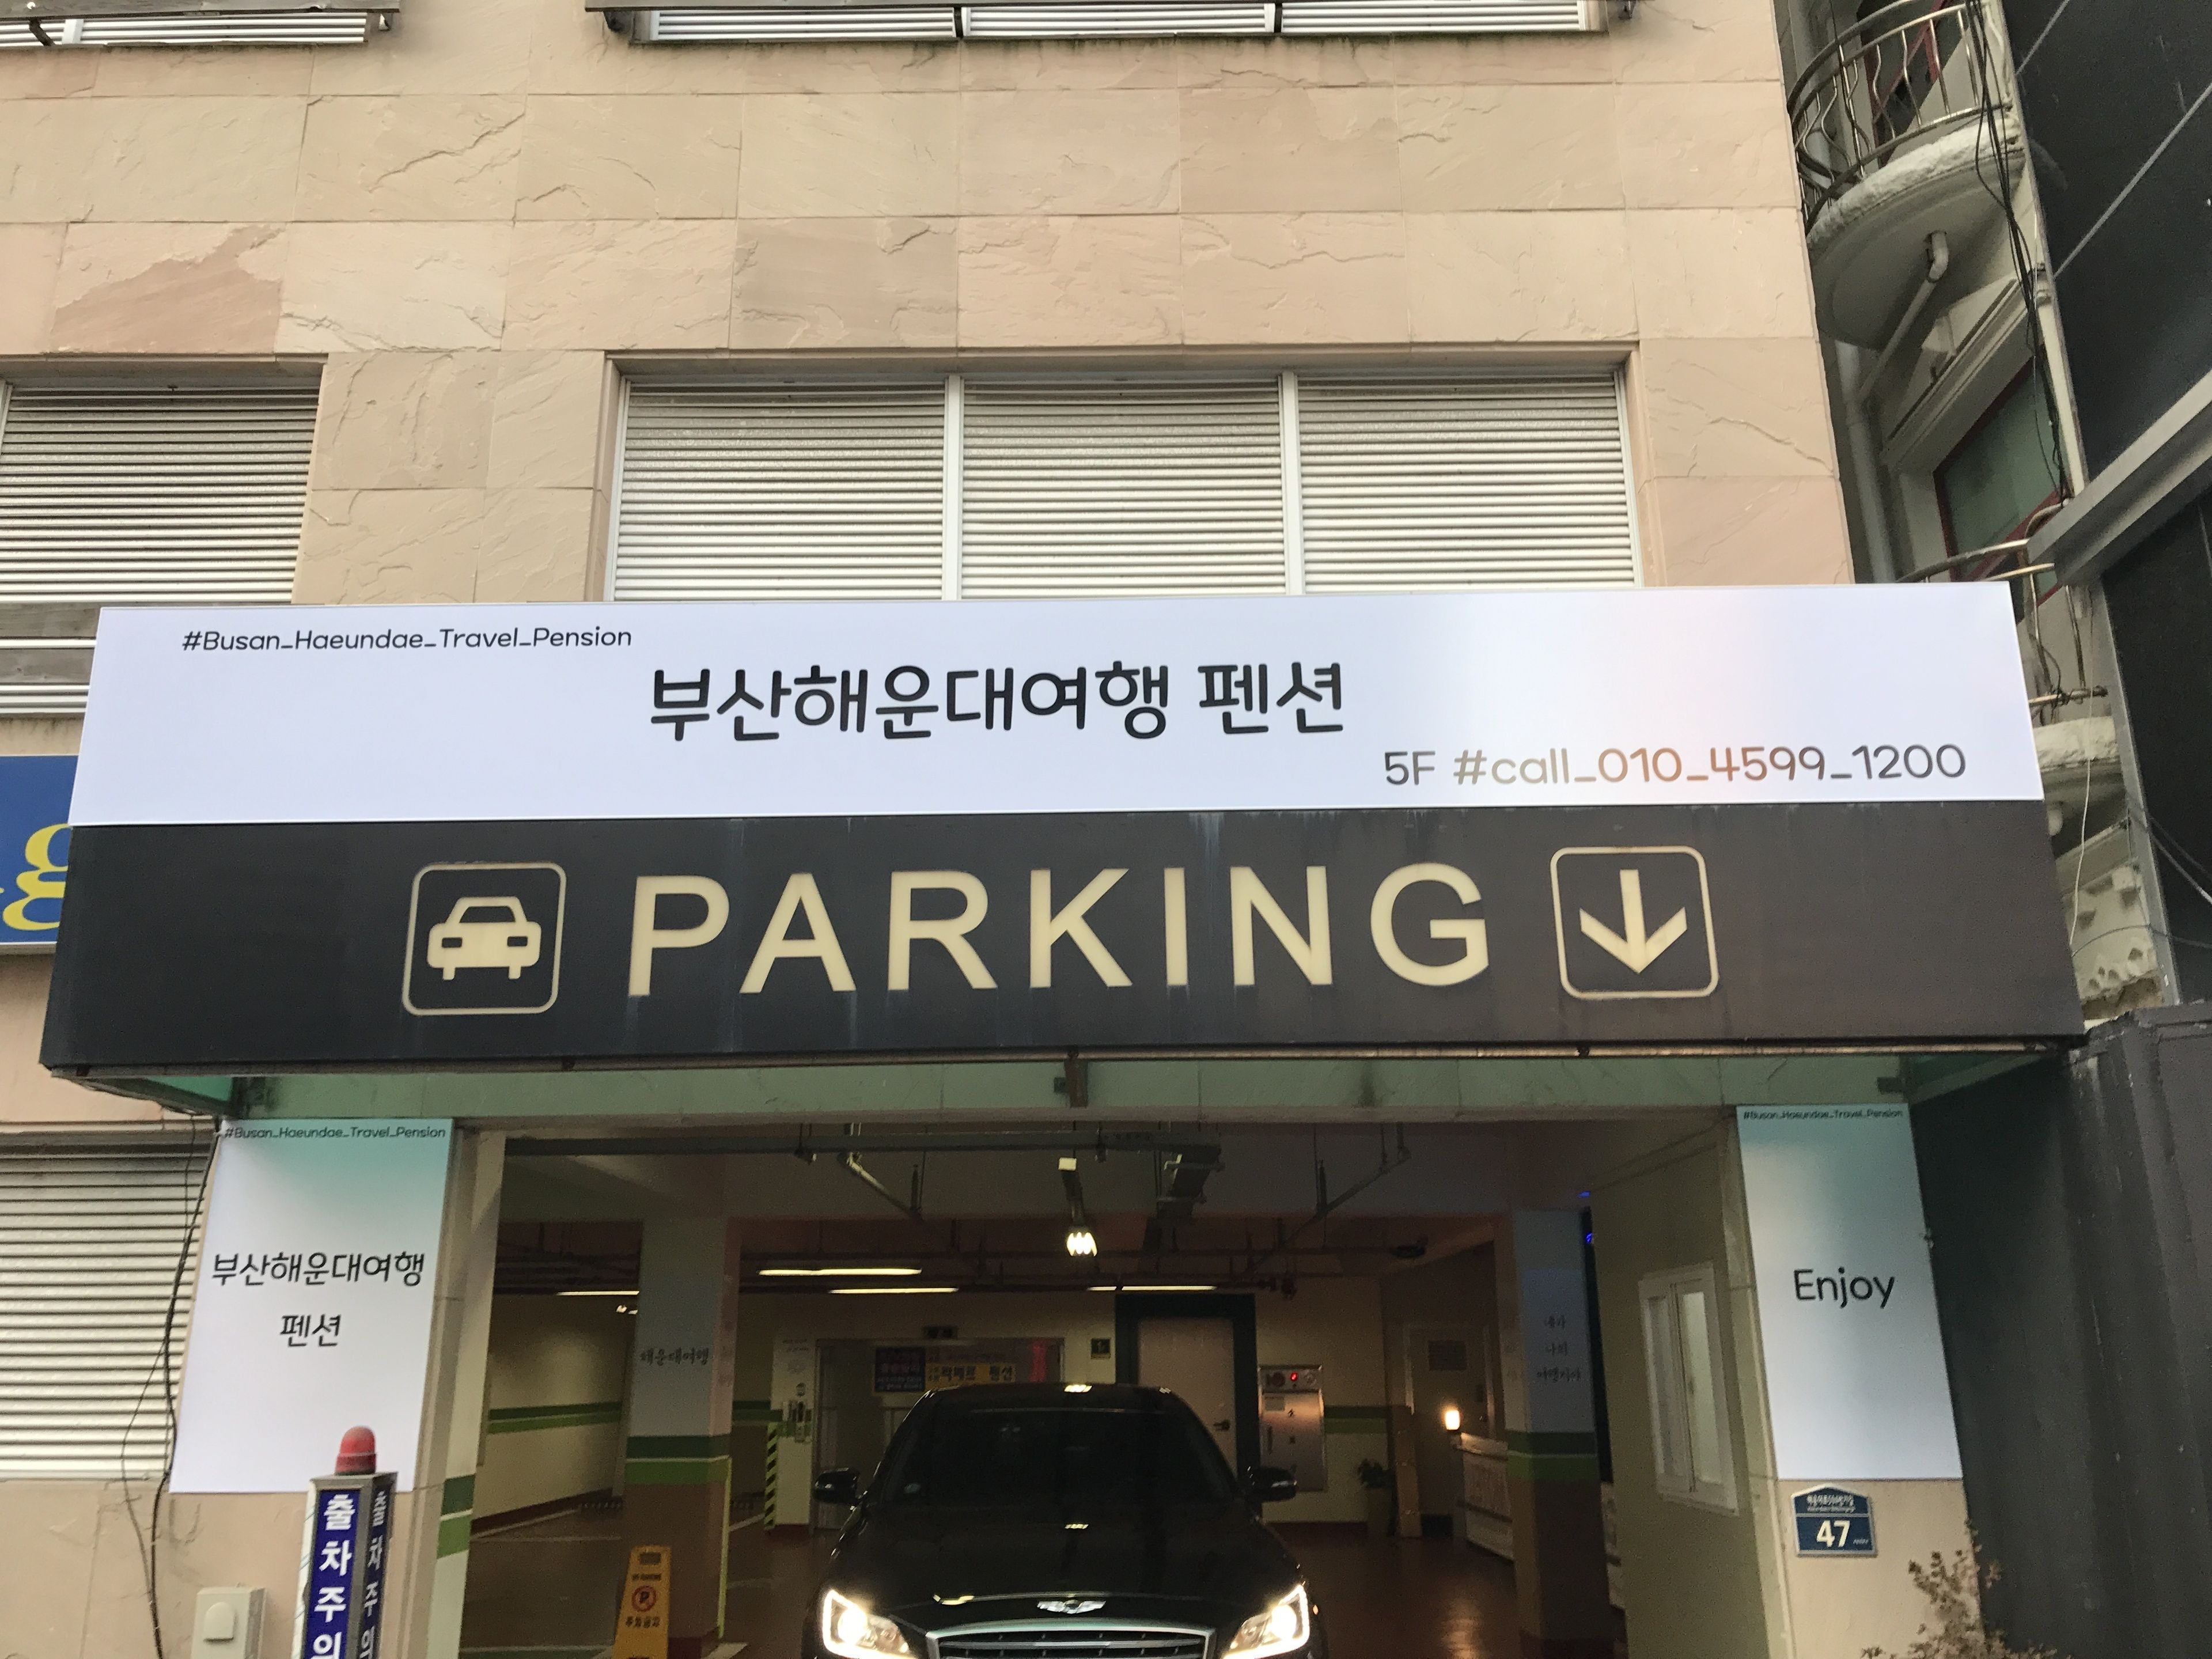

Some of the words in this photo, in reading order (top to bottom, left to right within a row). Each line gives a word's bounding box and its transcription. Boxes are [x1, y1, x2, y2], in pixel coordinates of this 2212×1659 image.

[181, 626, 632, 652] #Busan_Haeundae_Travel_Pension
[650, 660, 1169, 742] 부산해운대여행
[1197, 661, 1344, 735] 펜션
[1384, 751, 1436, 786] 5F
[1453, 743, 1967, 786] #call_010_4599_1200
[628, 862, 1489, 997] PARKING
[225, 1125, 446, 1139] #Busan_Haeundae_Travel_Pension
[212, 1251, 425, 1287] 부산해운대여행
[1793, 1267, 1895, 1309] Enjoy
[280, 1314, 342, 1347] 펜션
[1816, 1520, 1850, 1548] 47
[310, 1493, 356, 1659] 출차주의
